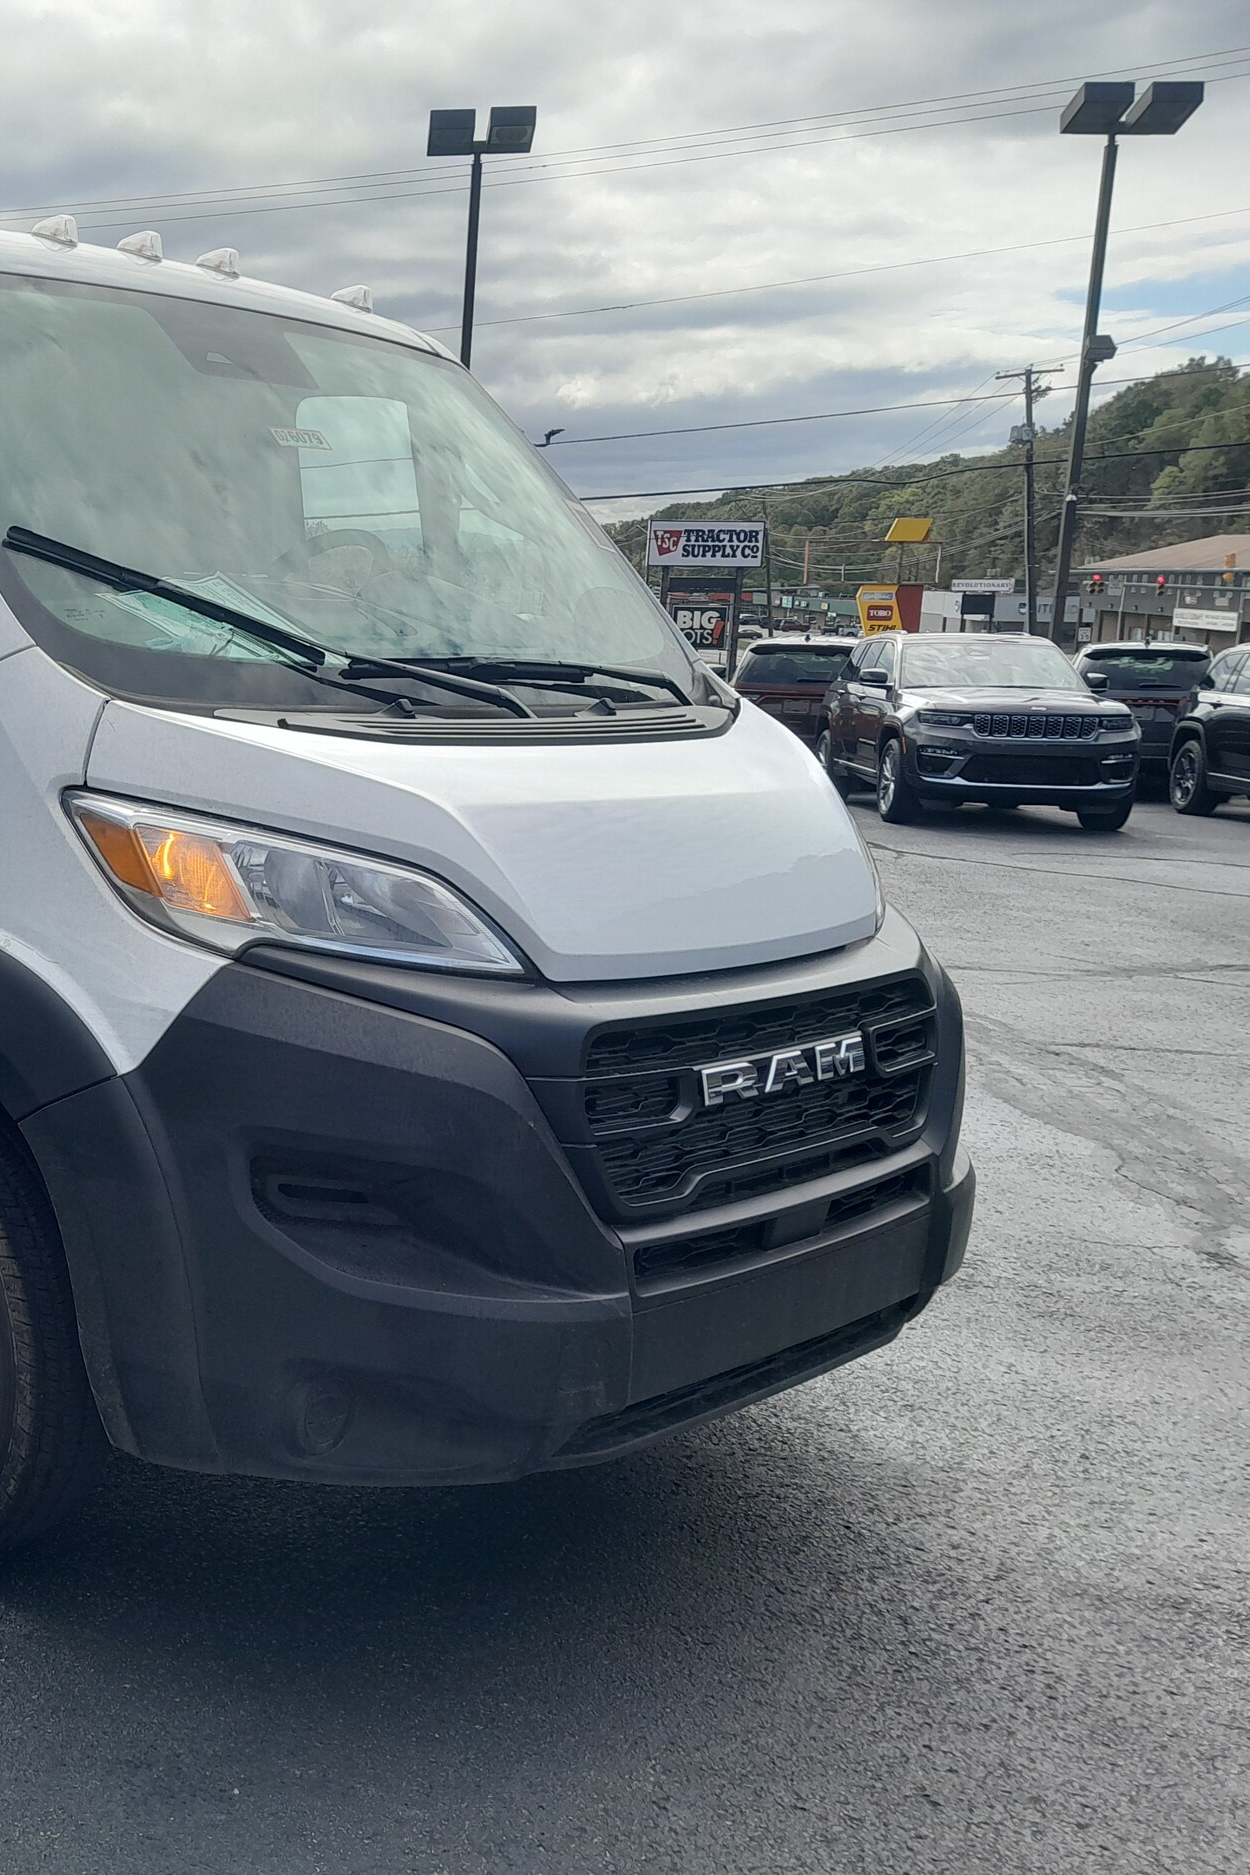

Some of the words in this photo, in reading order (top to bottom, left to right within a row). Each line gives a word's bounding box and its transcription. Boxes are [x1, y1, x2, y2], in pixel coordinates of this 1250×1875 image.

[655, 530, 678, 552] TSC
[683, 528, 760, 543] TRACTOR
[681, 543, 741, 559] SUPPLY
[676, 610, 722, 629] BIG
[869, 609, 892, 617] TORO
[701, 1036, 866, 1107] RAM
